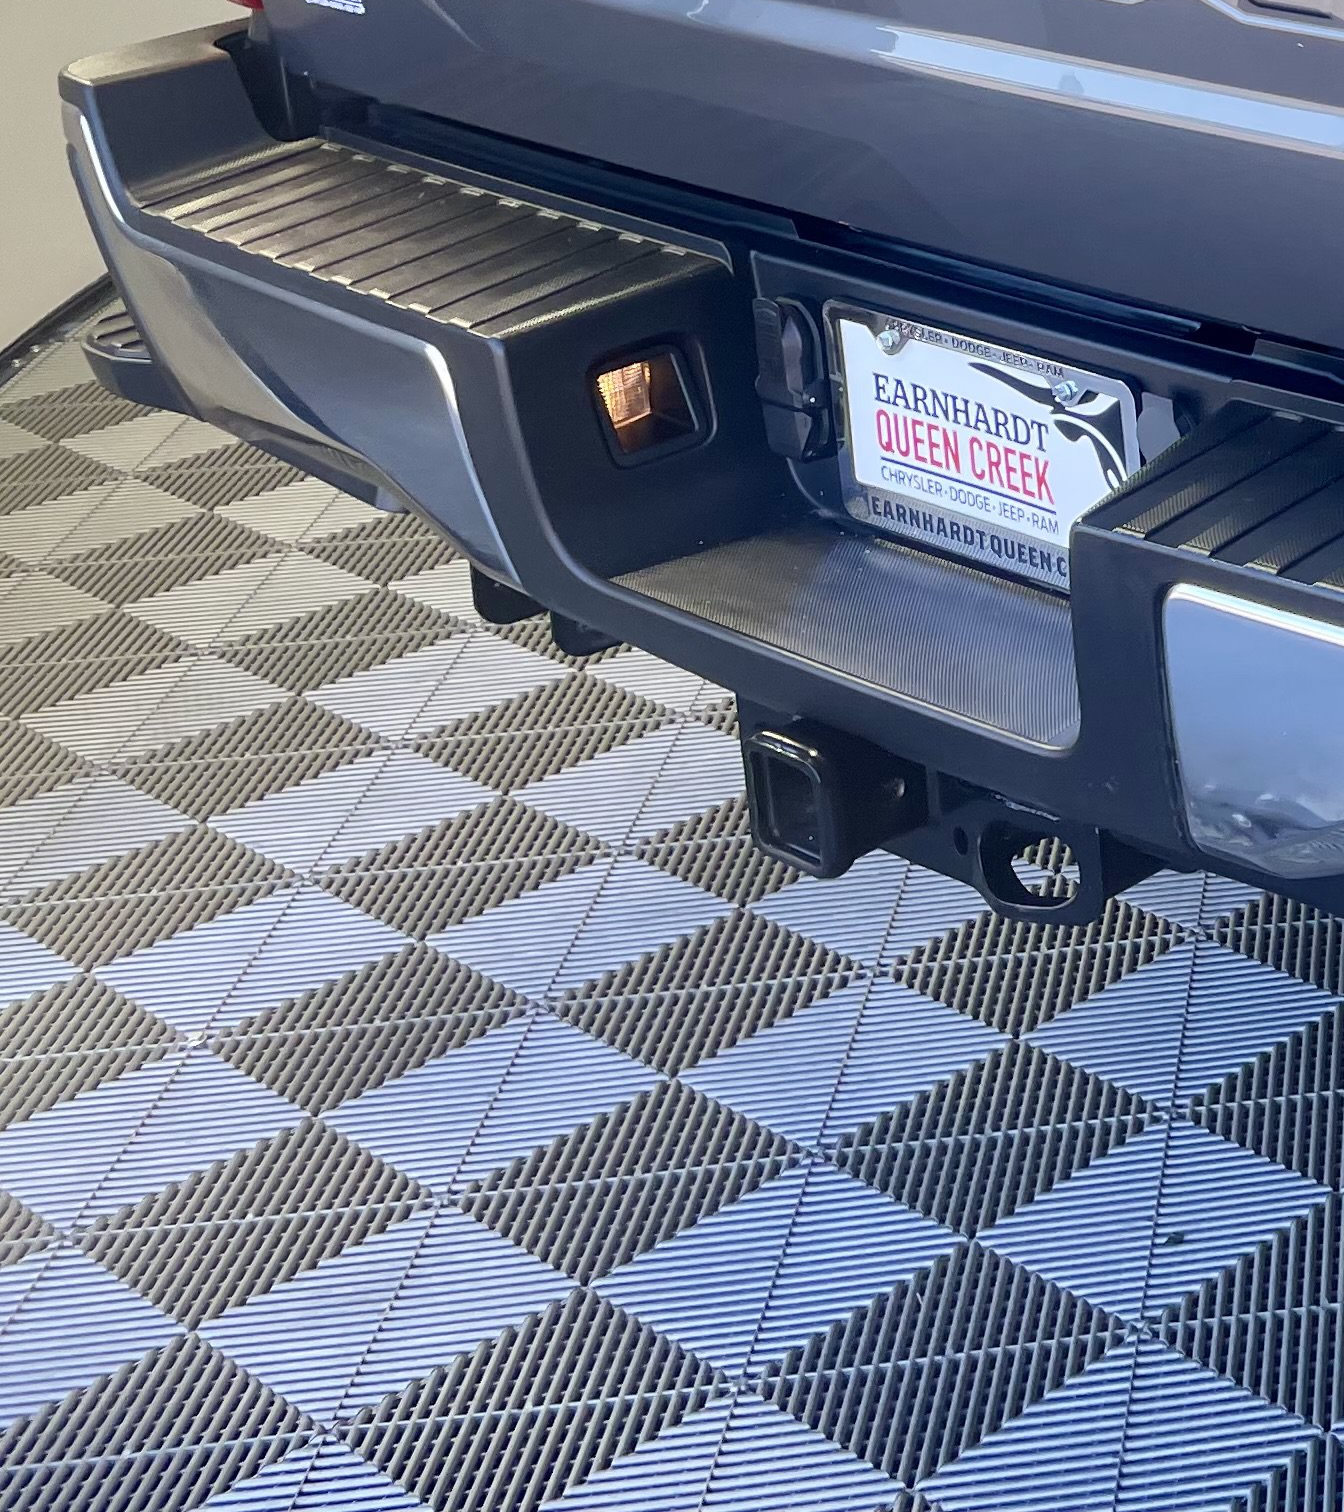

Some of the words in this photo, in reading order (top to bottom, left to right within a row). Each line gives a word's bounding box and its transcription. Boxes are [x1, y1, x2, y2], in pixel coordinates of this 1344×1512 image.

[951, 336, 993, 358] DODGE
[1000, 351, 1028, 366] JEEP
[872, 372, 1049, 453] EARNHARDT
[875, 408, 962, 475] QUEEN
[969, 436, 1056, 506] CREEK
[881, 465, 944, 498] CHRYSLER
[950, 488, 991, 513] DODGE
[998, 501, 1026, 524] JEEP
[1032, 513, 1060, 536] RAM
